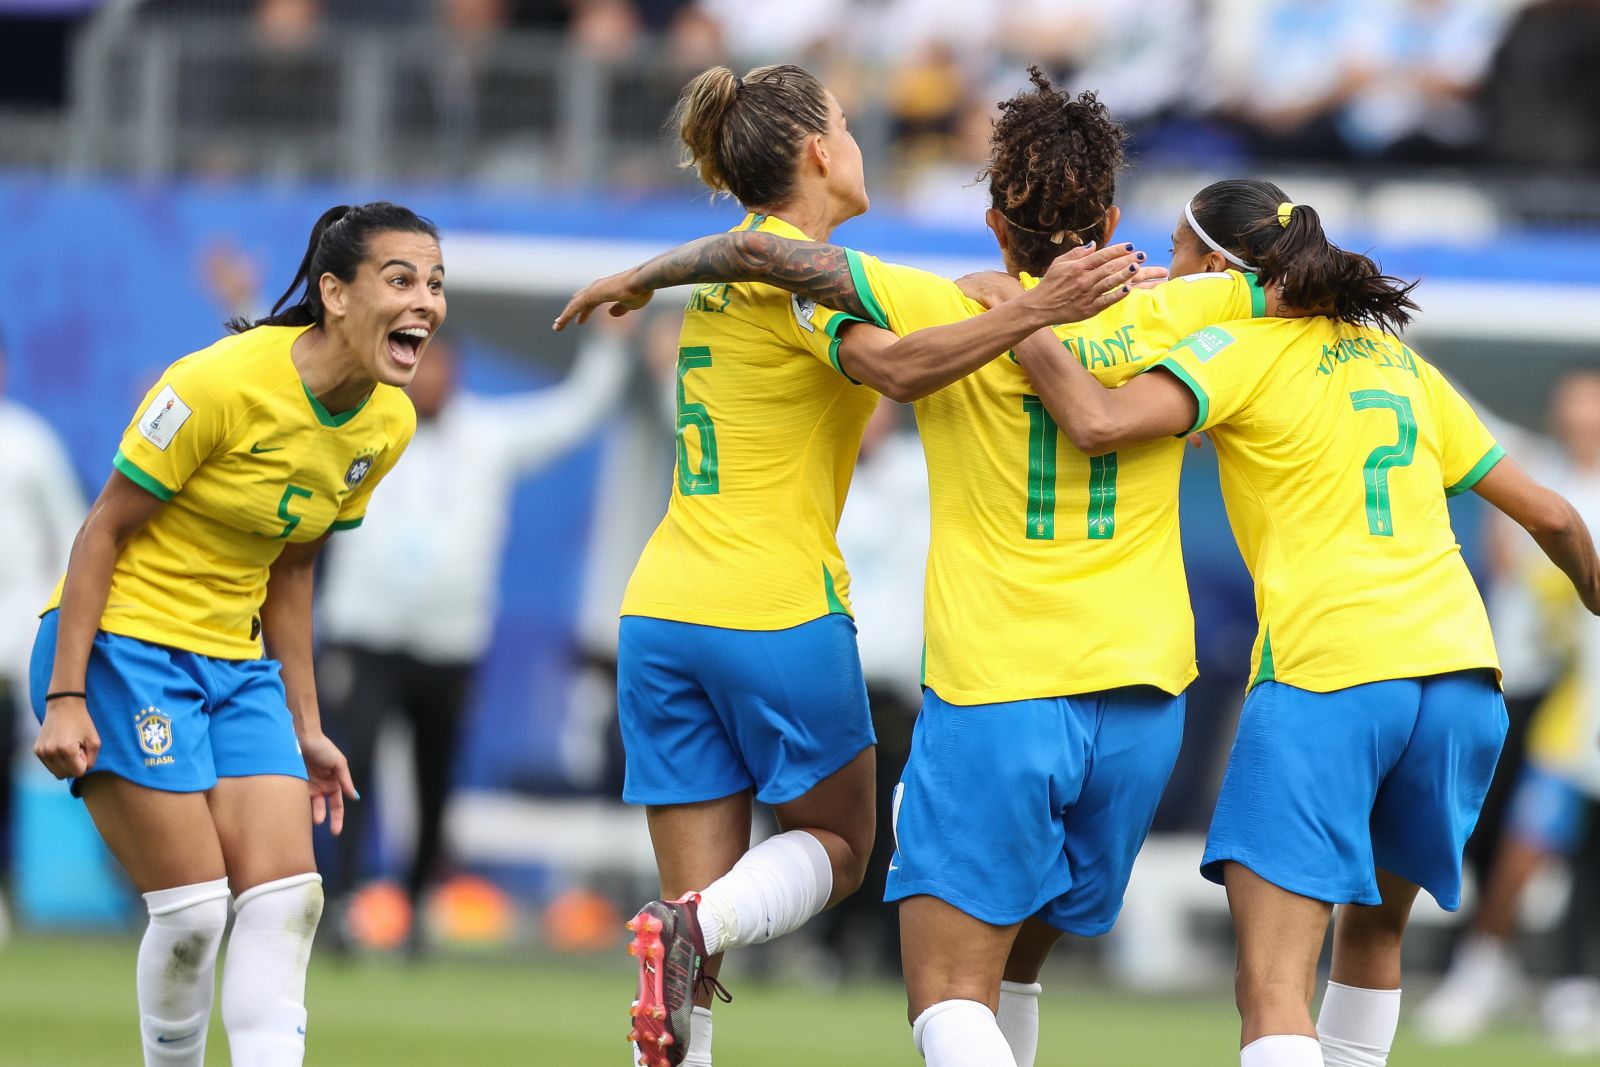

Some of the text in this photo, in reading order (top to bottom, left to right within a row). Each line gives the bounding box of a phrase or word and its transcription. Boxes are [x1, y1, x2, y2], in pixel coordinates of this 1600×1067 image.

[676, 346, 720, 496] 6
[1023, 394, 1118, 540] 11
[1349, 389, 1418, 537] 7
[268, 483, 314, 540] 5
[144, 756, 176, 767] BRASIL
